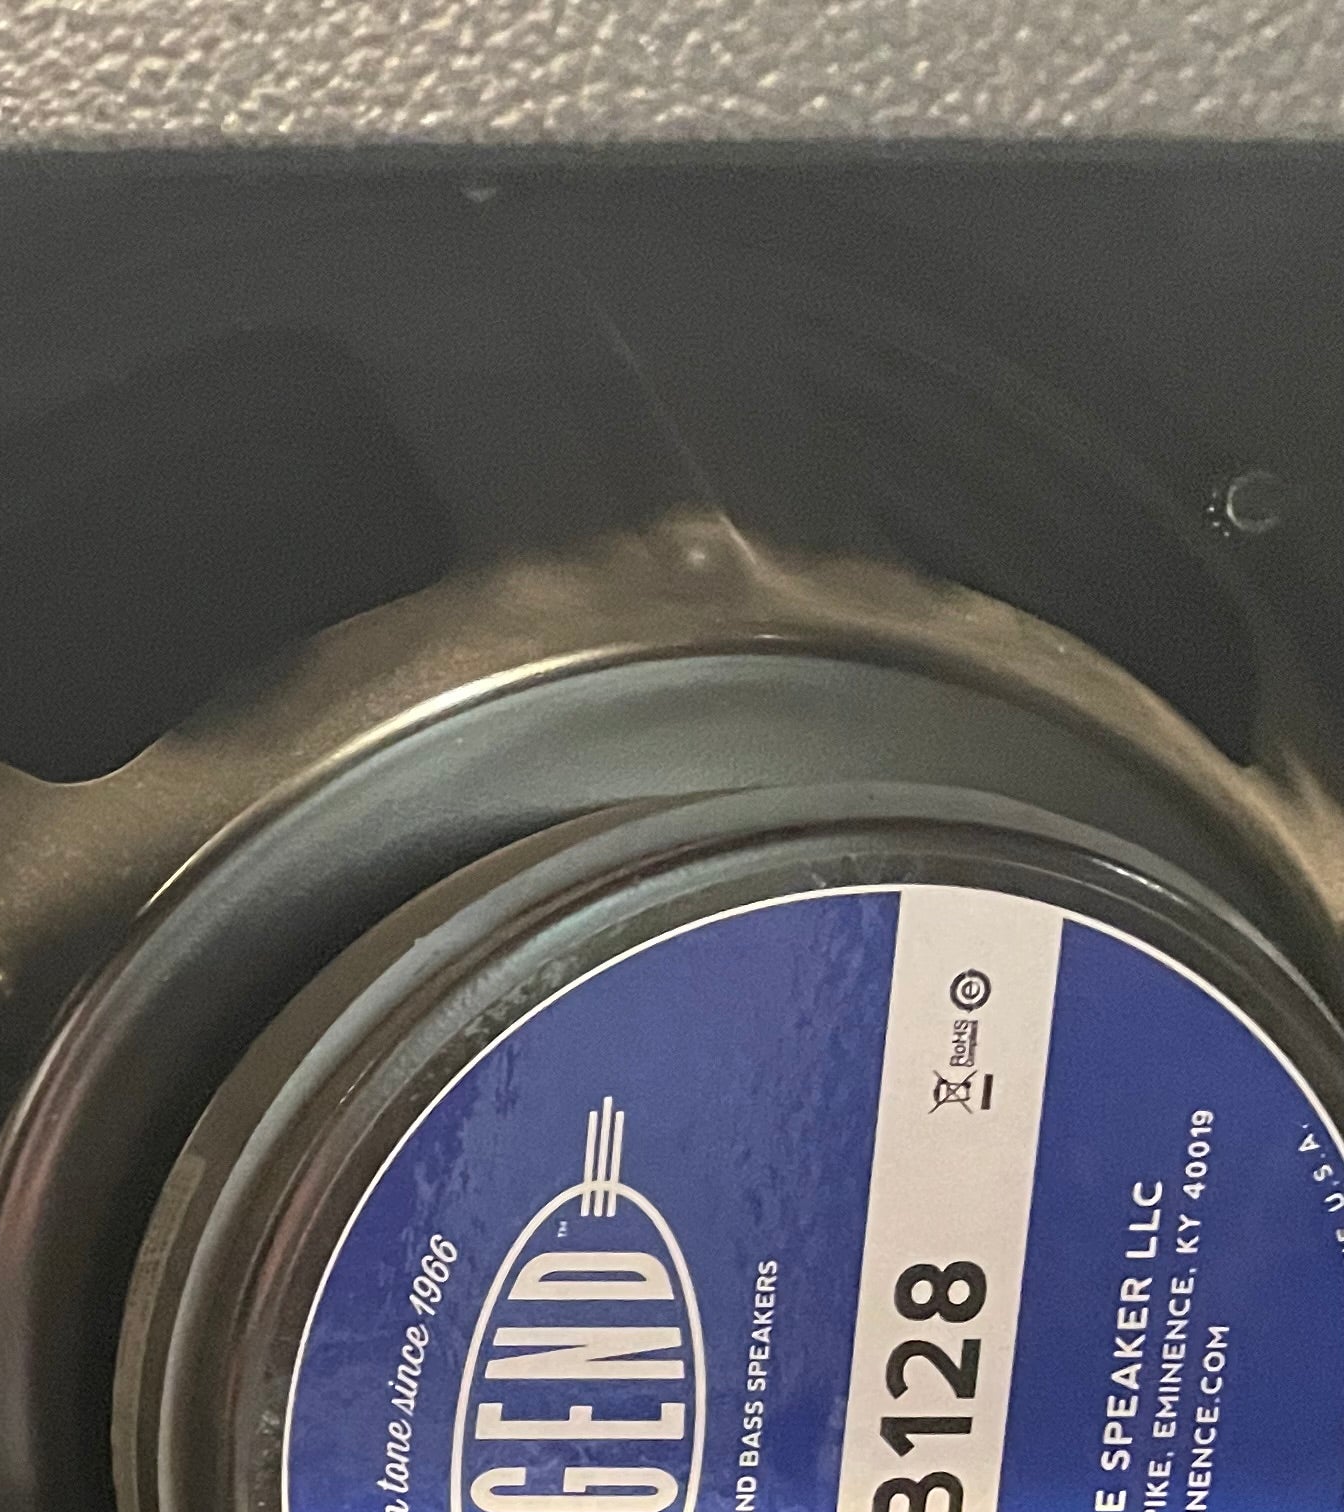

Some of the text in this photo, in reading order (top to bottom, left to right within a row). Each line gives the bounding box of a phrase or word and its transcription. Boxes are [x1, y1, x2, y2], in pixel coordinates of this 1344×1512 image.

[1182, 1110, 1215, 1199] 40019
[1125, 1181, 1163, 1258] LLC
[1176, 1213, 1202, 1254] KY
[409, 1234, 459, 1317] 1966
[747, 1260, 778, 1391] SPEAKERS
[388, 1323, 430, 1417] since
[1101, 1277, 1152, 1471] SPEAKER
[376, 1419, 413, 1494] tone
[739, 1399, 764, 1467] BASS
